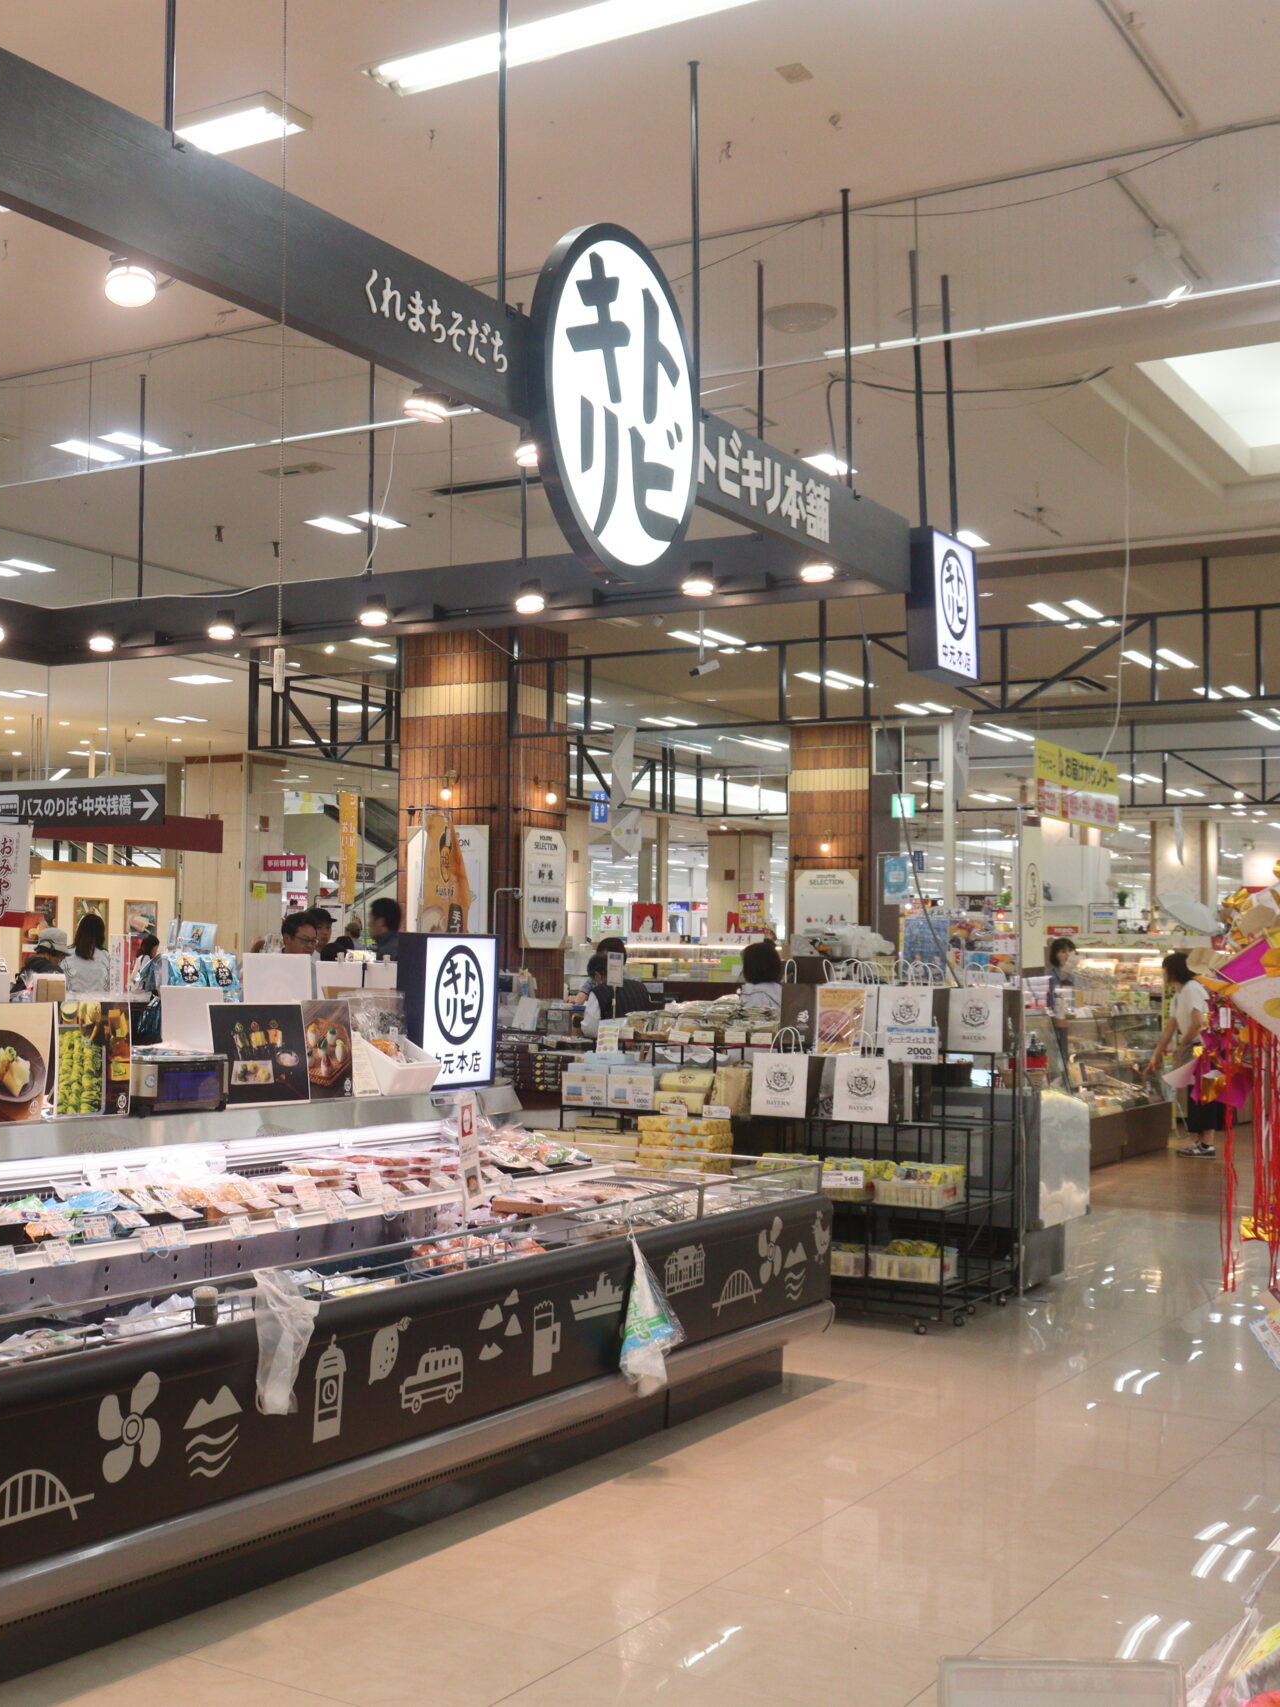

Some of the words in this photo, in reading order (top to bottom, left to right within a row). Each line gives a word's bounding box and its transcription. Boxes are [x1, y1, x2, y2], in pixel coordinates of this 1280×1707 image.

[364, 268, 509, 374] くれまちそだち
[21, 793, 132, 817] バスのりば・中央桟橋
